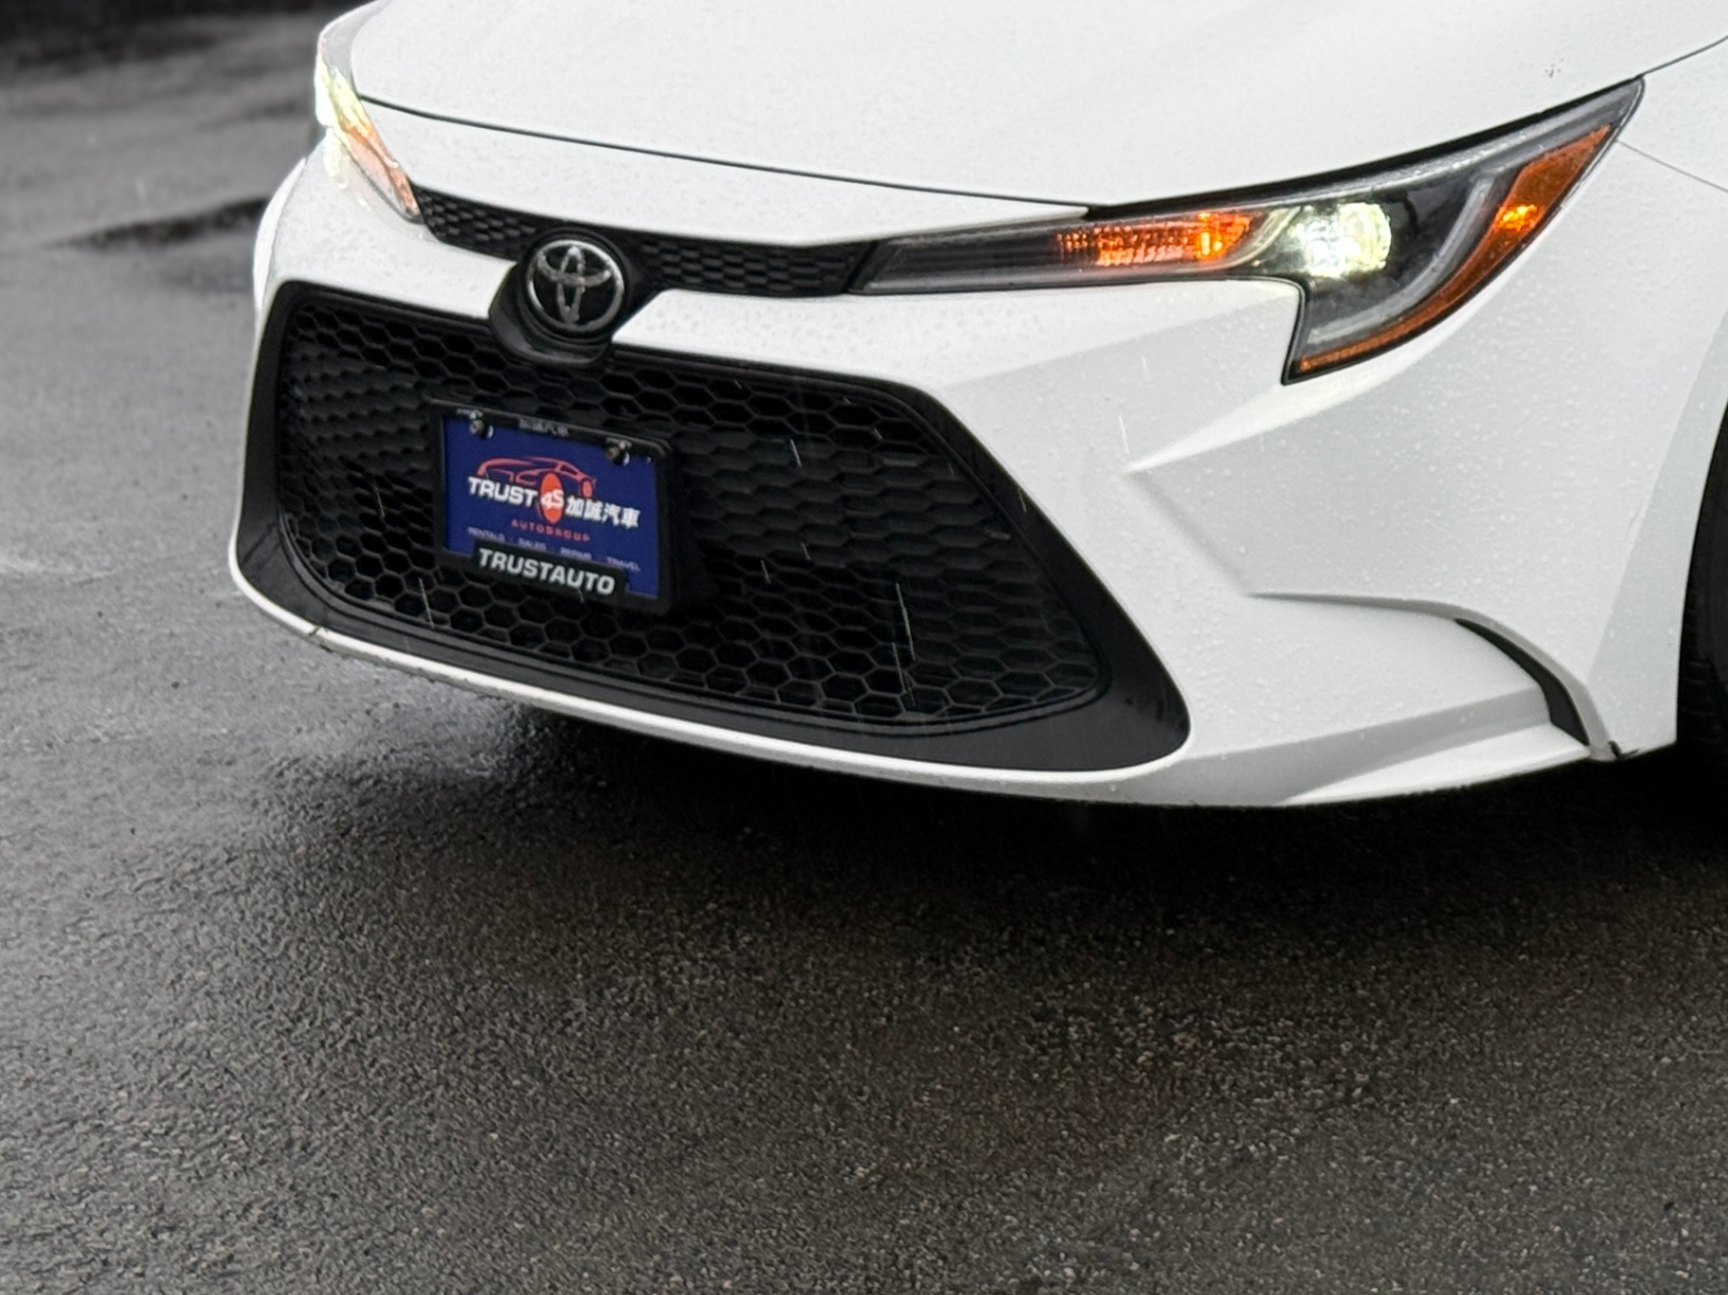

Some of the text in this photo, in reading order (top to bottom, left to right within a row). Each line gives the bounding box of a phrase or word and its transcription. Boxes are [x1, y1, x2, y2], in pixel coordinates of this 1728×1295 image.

[467, 476, 538, 508] TRUST
[511, 519, 591, 543] AUTOGROUP
[479, 548, 616, 596] TRUSTAUTO
